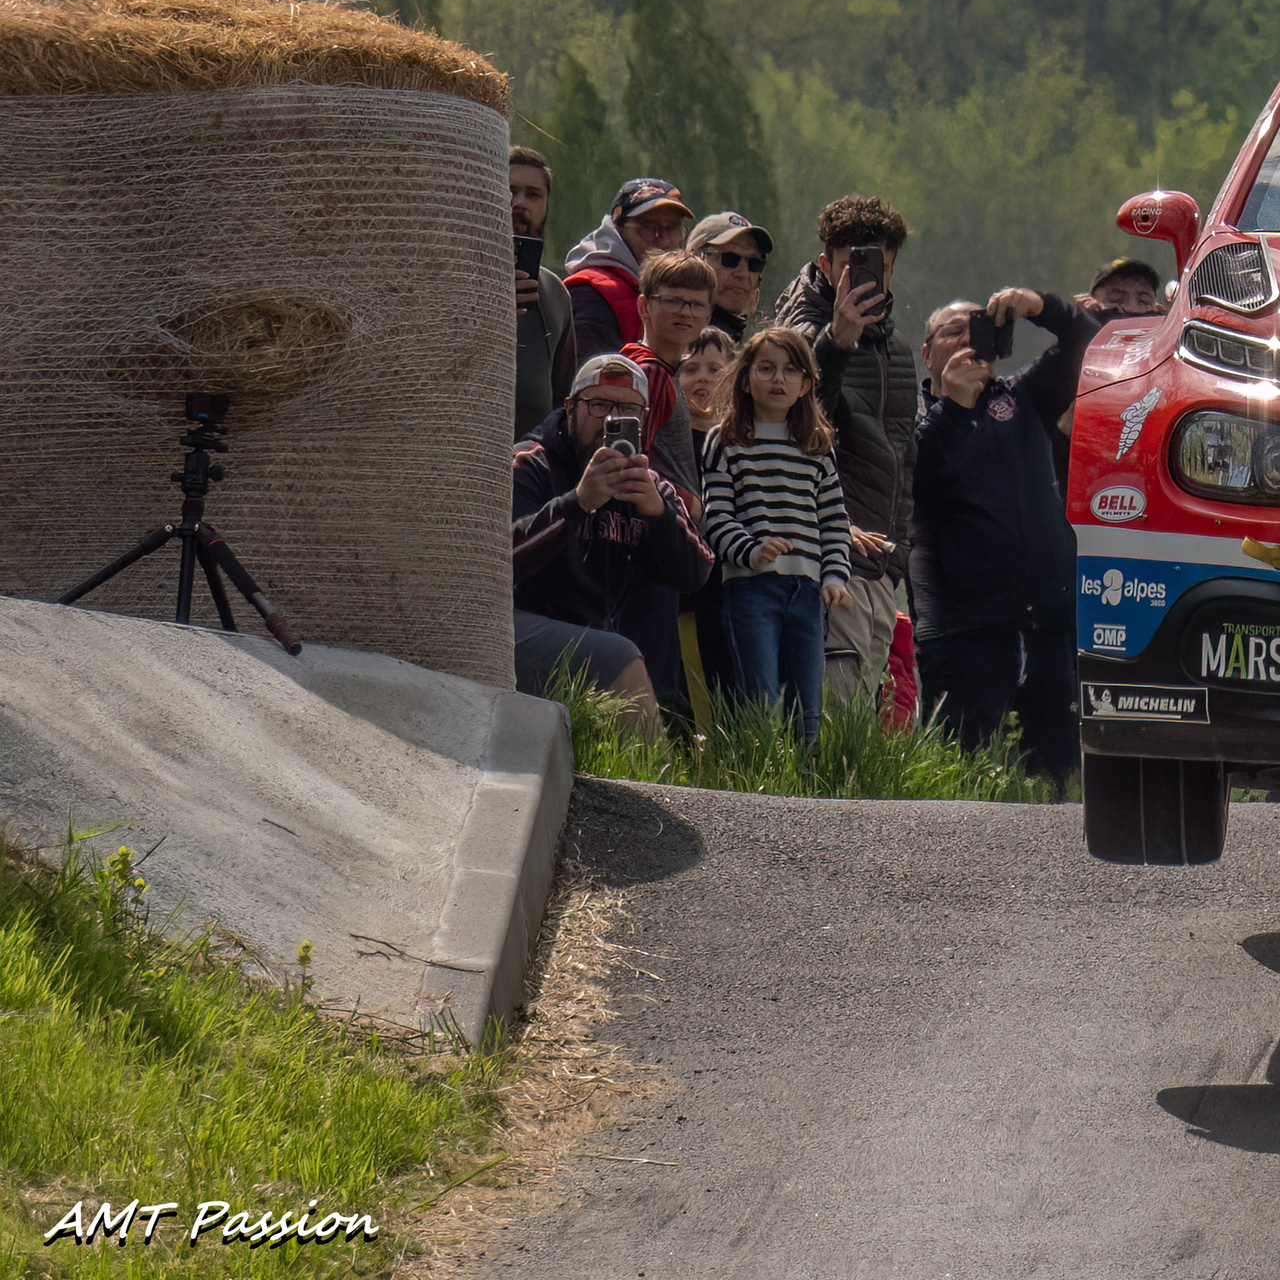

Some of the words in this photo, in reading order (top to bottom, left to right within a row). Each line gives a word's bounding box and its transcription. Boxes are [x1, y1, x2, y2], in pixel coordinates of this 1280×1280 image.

[1131, 208, 1162, 216] RACING
[1097, 495, 1138, 511] BELL
[1093, 628, 1126, 646] OMP
[1117, 696, 1197, 713] MICHELIN
